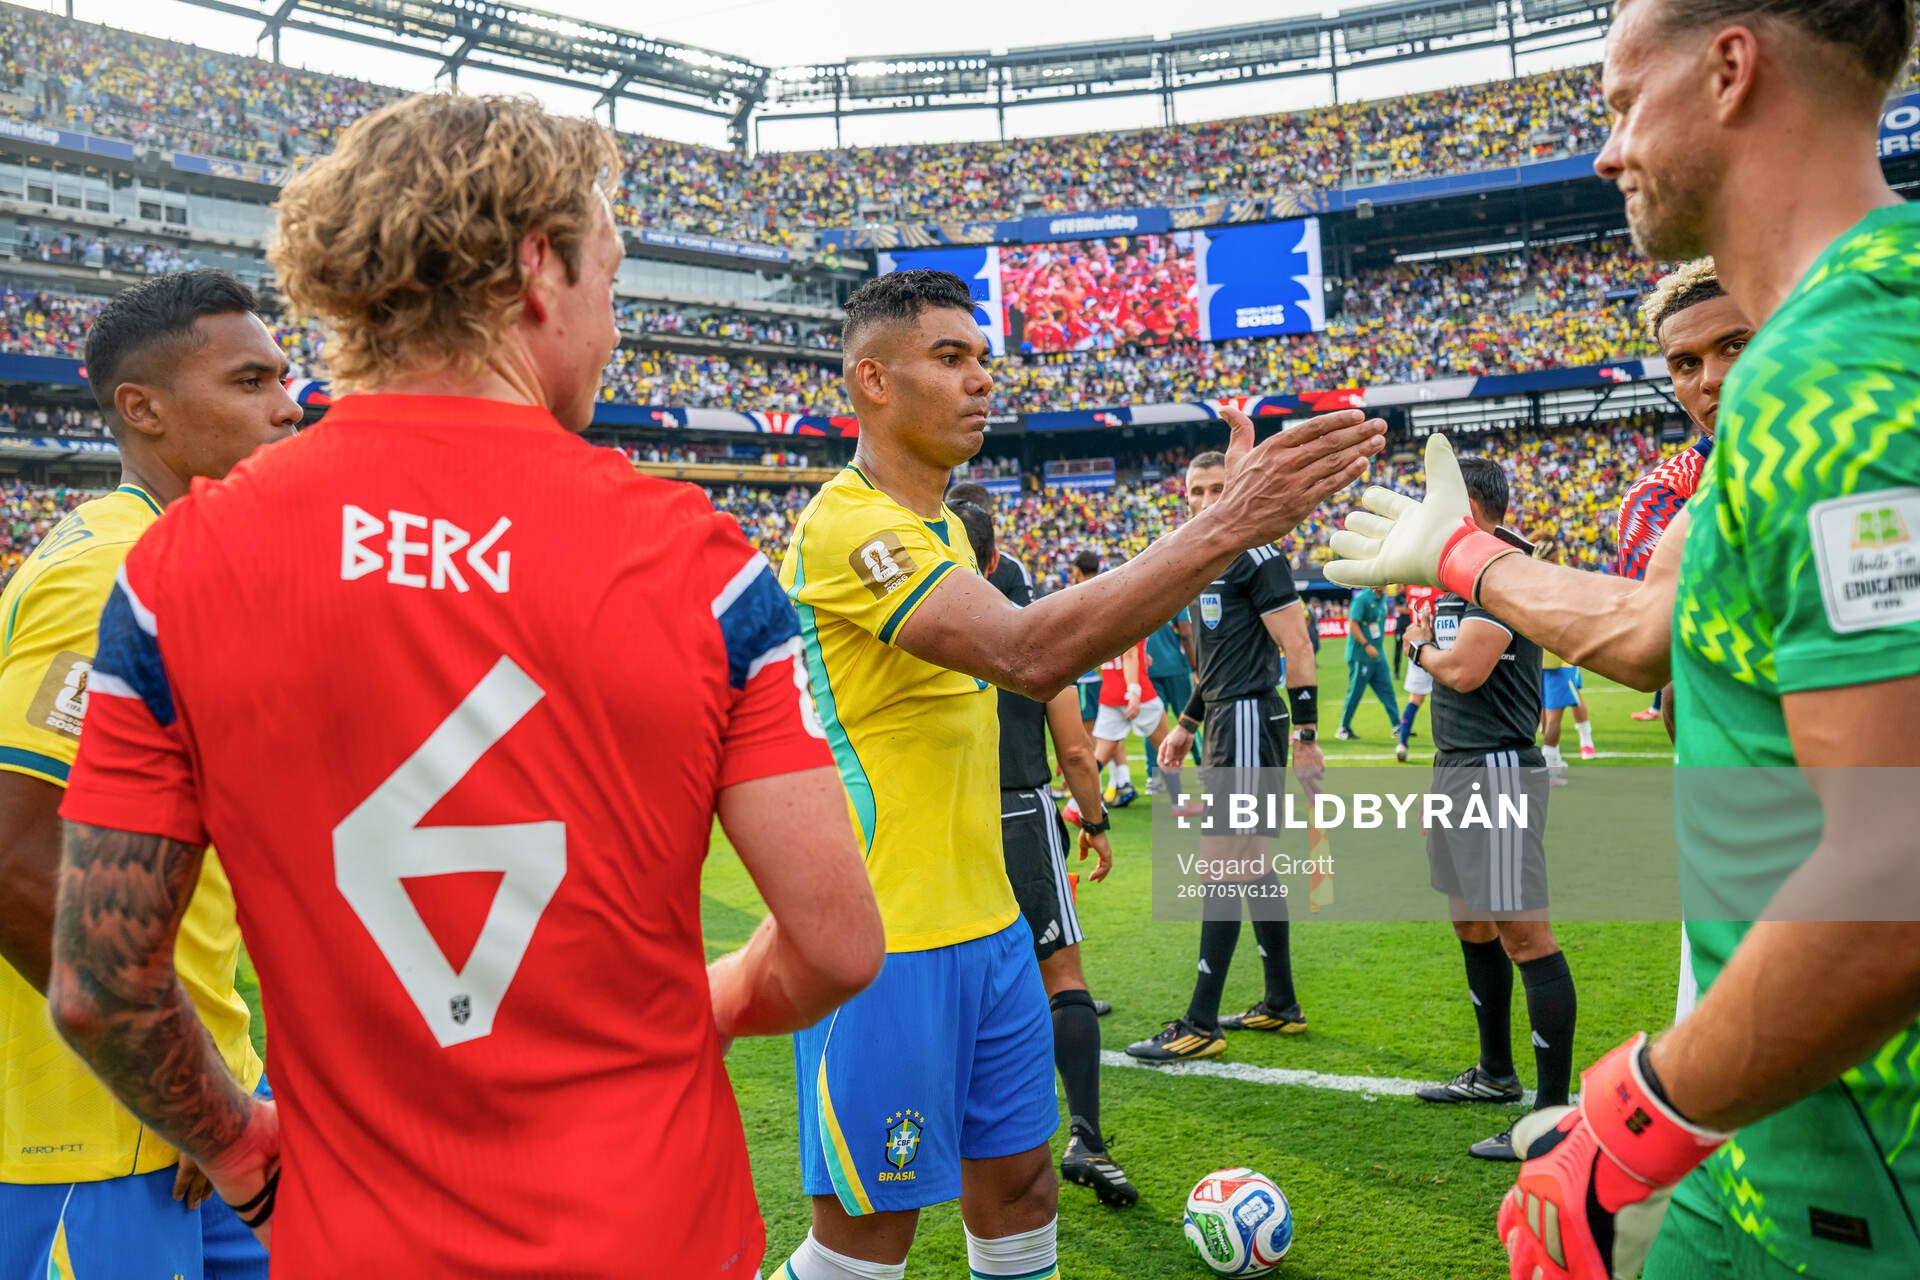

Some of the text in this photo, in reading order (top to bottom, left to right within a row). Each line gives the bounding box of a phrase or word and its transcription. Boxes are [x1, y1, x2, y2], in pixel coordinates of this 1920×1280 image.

[647, 232, 676, 245] NEW
[677, 236, 709, 249] YORK
[711, 240, 739, 252] NEW
[1236, 313, 1285, 328] 2026
[340, 504, 513, 594] BERG
[1842, 572, 1920, 601] EDUCATIO
[1436, 619, 1456, 630] FIFA
[45, 716, 82, 736] 2026
[333, 653, 567, 1049] 6
[21, 1144, 84, 1154] AERO-FIT
[879, 1170, 916, 1182] BRASIL
